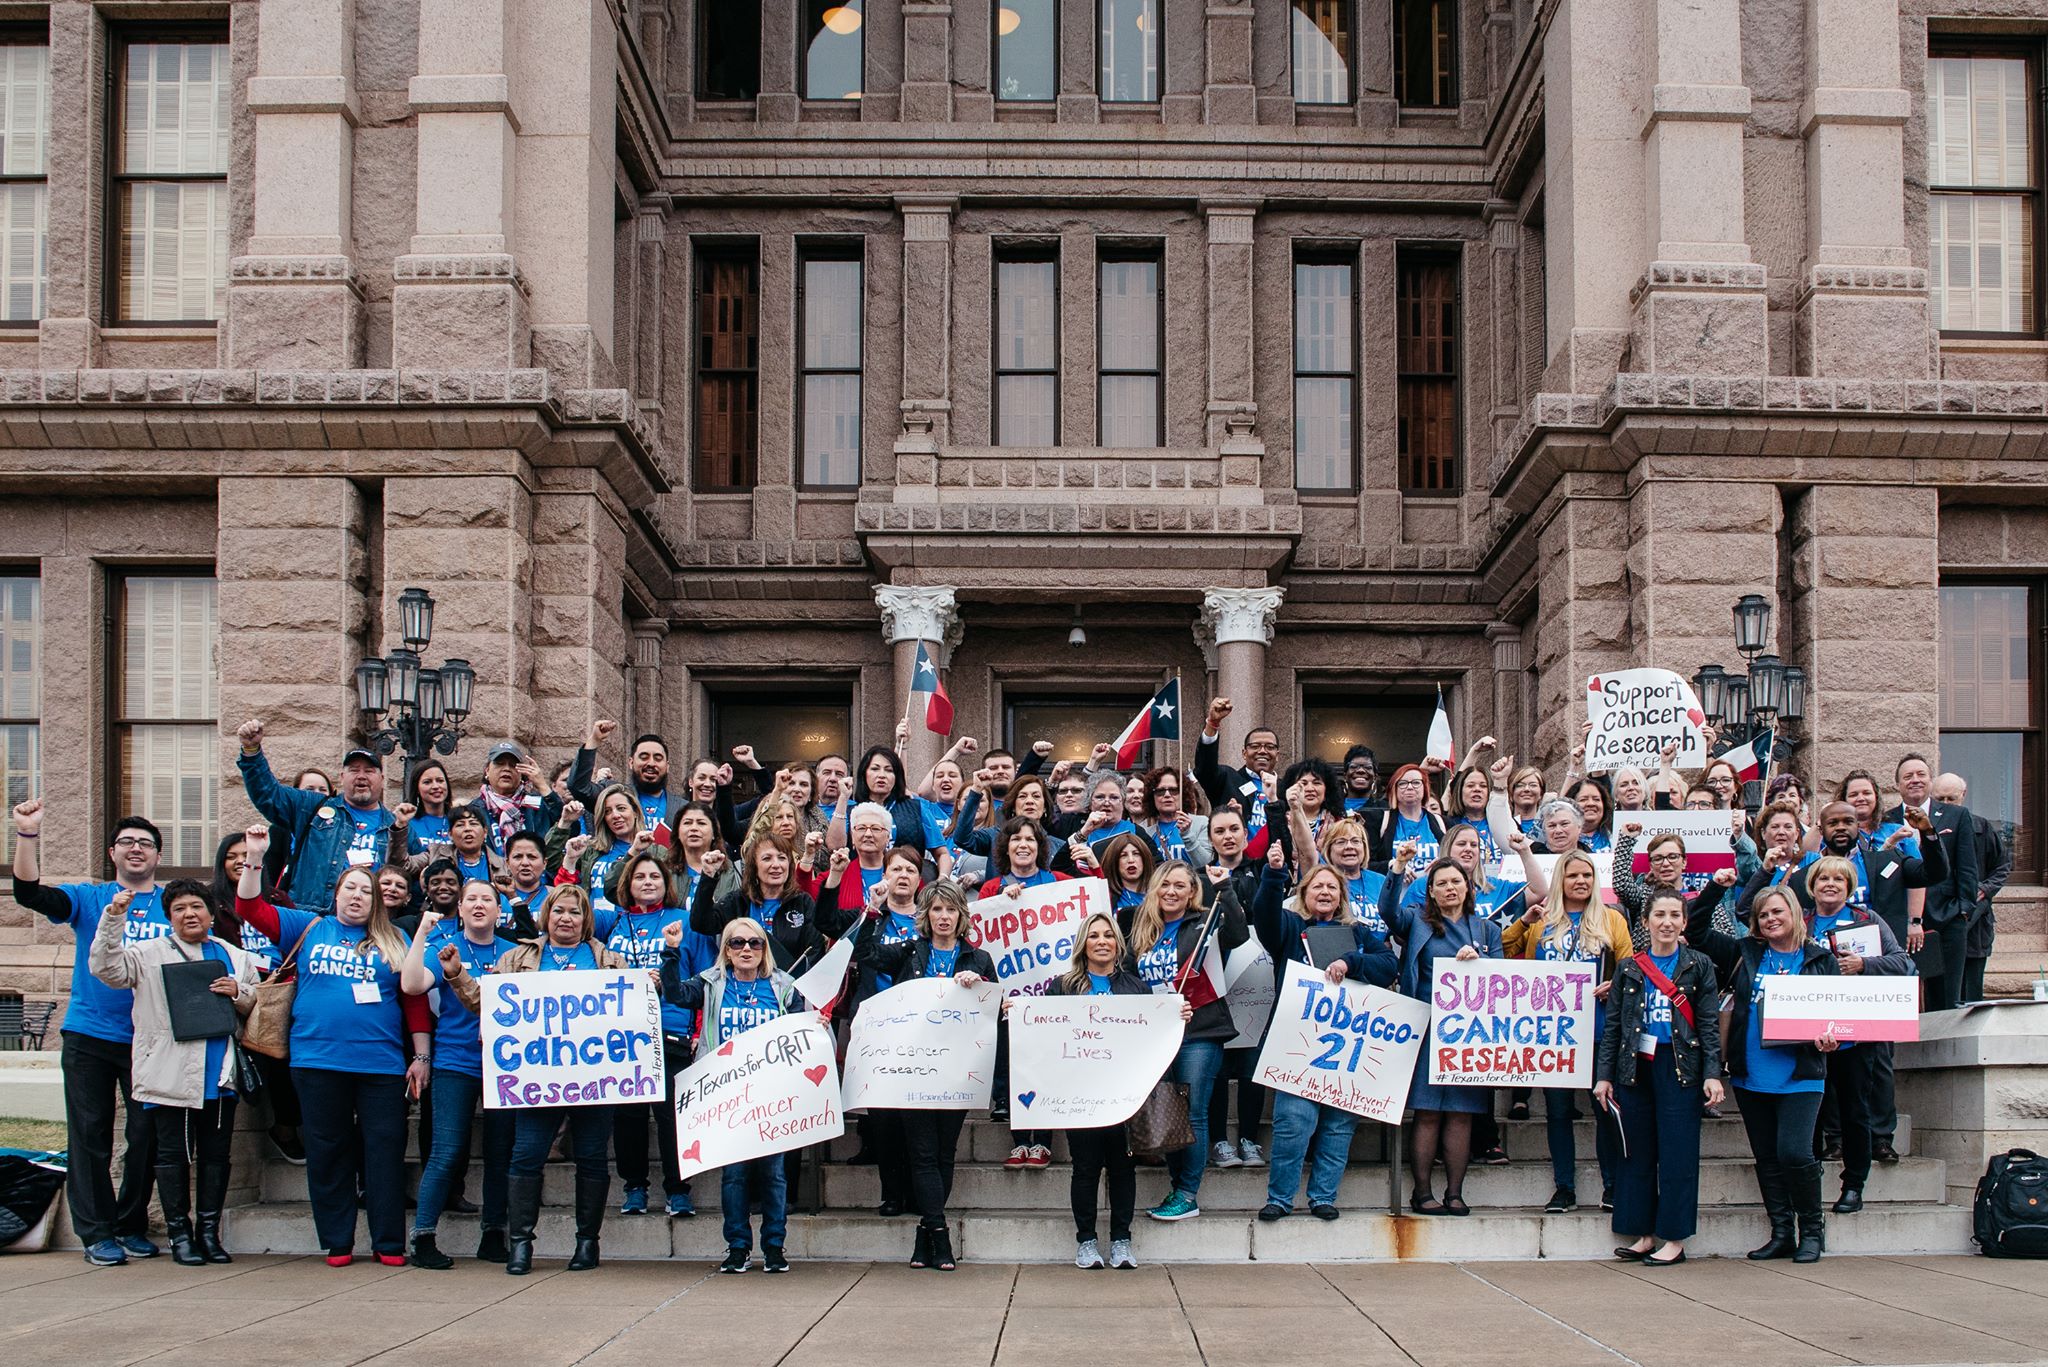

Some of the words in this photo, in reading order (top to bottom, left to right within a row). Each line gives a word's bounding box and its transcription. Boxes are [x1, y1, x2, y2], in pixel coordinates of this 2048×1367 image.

[1604, 677, 1683, 711] Support
[1603, 706, 1687, 732] Cancer
[1593, 726, 1696, 759] Research
[124, 921, 170, 938] GHT
[965, 886, 1090, 949] Support
[310, 943, 378, 966] FIGHT
[609, 935, 666, 951] FIGHT
[997, 934, 1076, 979] ance
[1138, 948, 1178, 966] FIGH
[309, 960, 376, 981] CANCER
[1139, 963, 1178, 982] CANCE
[492, 975, 634, 1035] Support
[1434, 972, 1592, 1014] SUPPORT
[1771, 993, 1912, 1003] #saveCPRITsaveLIVES
[1436, 1013, 1578, 1045] CANCER
[493, 1028, 652, 1072] Cancer
[861, 1044, 890, 1057] Fund
[1062, 1042, 1112, 1060] Lives
[1309, 1032, 1365, 1073] 21
[1438, 1046, 1576, 1074] RESEARCH
[873, 1065, 938, 1076] research
[496, 1065, 657, 1107] Research
[1264, 1066, 1304, 1085] Raise
[1308, 1077, 1320, 1090] the
[1351, 1087, 1395, 1110] Prevent
[1301, 1089, 1326, 1104] early
[728, 1096, 799, 1129] Cancer
[758, 1099, 836, 1142] Research
